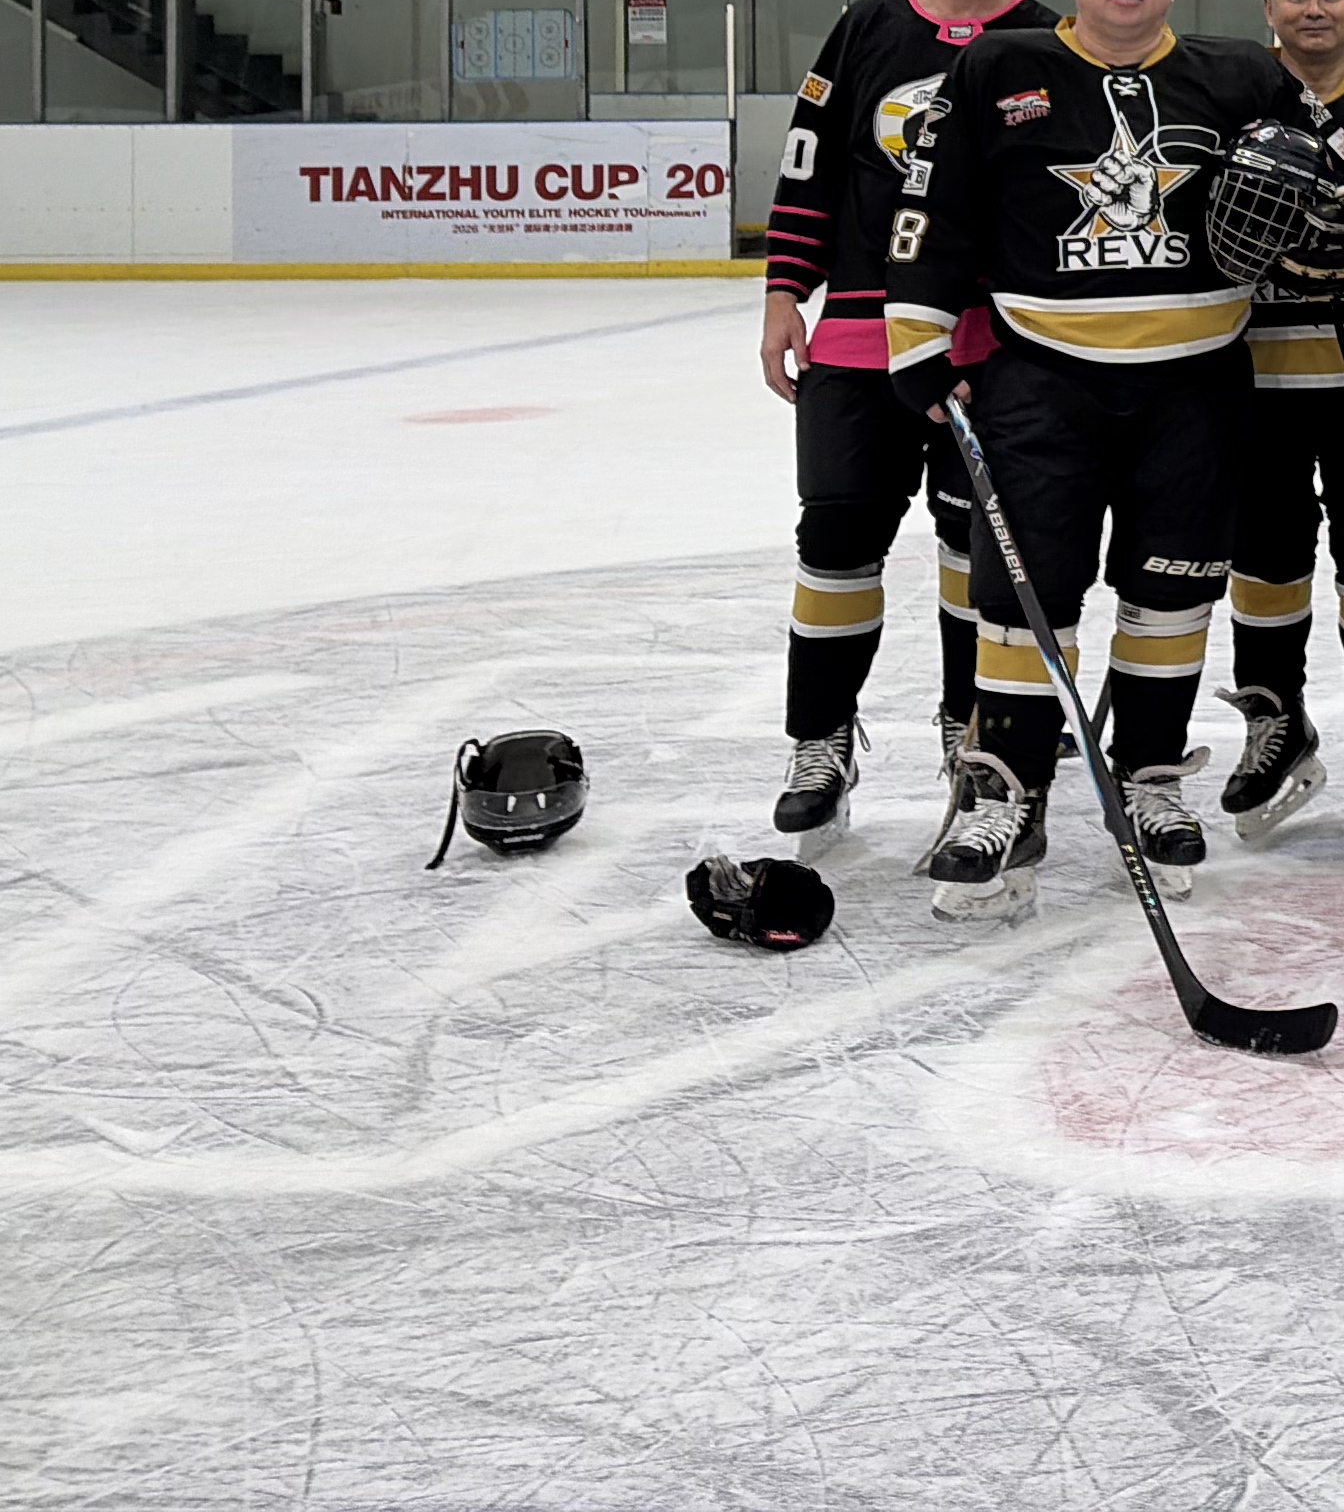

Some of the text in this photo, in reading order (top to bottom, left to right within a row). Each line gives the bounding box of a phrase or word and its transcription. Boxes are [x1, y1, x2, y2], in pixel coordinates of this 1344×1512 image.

[299, 164, 519, 202] TIANZHU
[535, 163, 640, 201] CUP
[381, 208, 480, 220] INTERNATIONAL
[482, 208, 526, 219] YOUTH
[528, 208, 563, 219] ELITE
[568, 207, 621, 218] HOCKEY
[888, 207, 930, 263] 8
[1059, 234, 1190, 270] REVS
[988, 512, 1027, 584] BAUER
